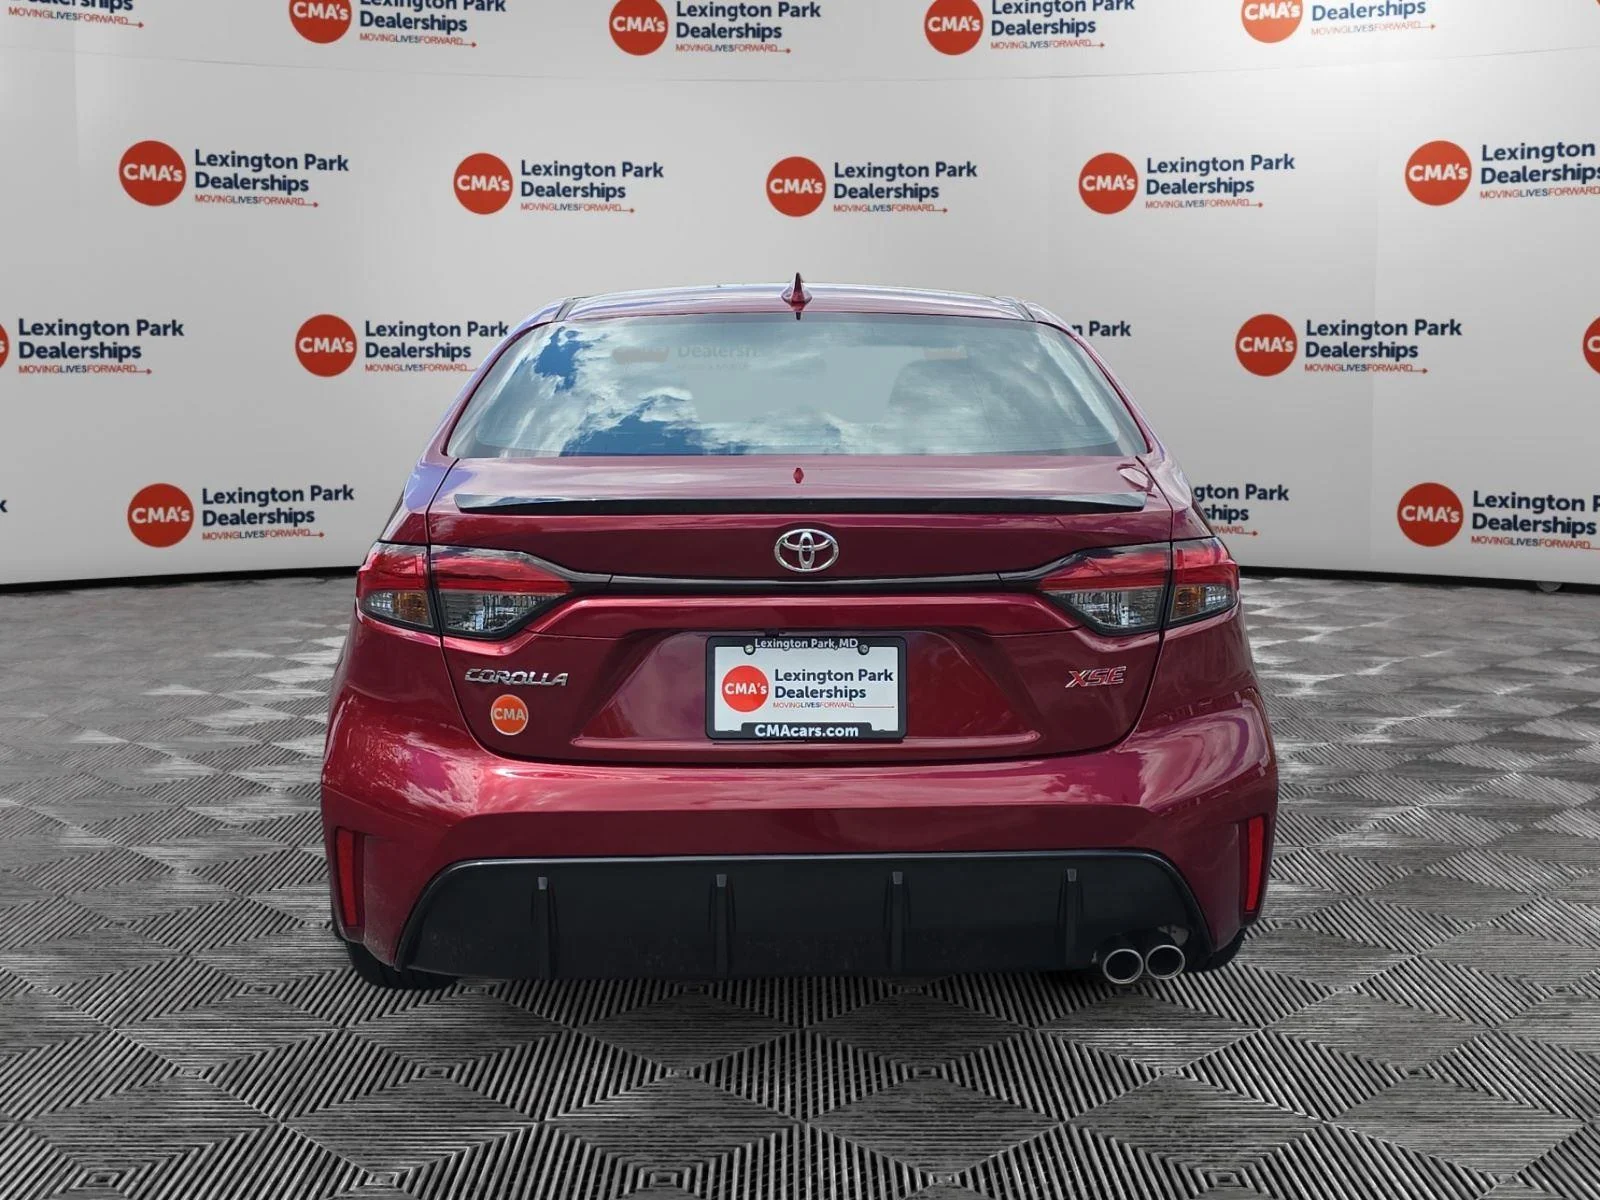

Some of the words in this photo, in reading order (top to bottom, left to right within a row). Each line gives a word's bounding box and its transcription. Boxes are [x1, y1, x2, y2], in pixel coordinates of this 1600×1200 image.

[293, 2, 349, 20] CMA's
[360, 0, 457, 12] xngton
[676, 1, 772, 21] Lexington
[778, 1, 821, 17] Park
[991, 0, 1086, 17] Lexington
[1093, 0, 1135, 11] Park
[1244, 2, 1301, 20] CMA's
[1312, 0, 1426, 21] Dealerships
[360, 11, 468, 35] Dealerships
[613, 16, 666, 32] CMA's
[676, 22, 782, 41] Dealerships
[928, 16, 981, 32] CMA's
[991, 18, 1096, 37] Dealerships
[195, 149, 298, 172] Lexington
[304, 153, 349, 171] Park
[1482, 141, 1595, 163] Lexington
[123, 163, 183, 182] CMA's
[521, 160, 615, 180] Lexington
[622, 162, 664, 178] Park
[834, 162, 929, 182] Lexington
[935, 161, 977, 177] Park
[1147, 157, 1244, 176] Lexington
[1250, 153, 1295, 171] Park
[1408, 163, 1469, 182] CMA's
[195, 171, 309, 195] Dealerships
[456, 174, 510, 192] CMA's
[521, 181, 626, 201] Dealerships
[770, 178, 823, 194] CMA's
[1082, 174, 1135, 191] CMA's
[1146, 177, 1255, 197] Dealerships
[834, 183, 939, 202] Dealerships
[19, 318, 130, 339] Lexington
[136, 318, 184, 336] Park
[365, 320, 461, 341] Lexington
[467, 321, 508, 337] Park
[1089, 320, 1131, 337] Park
[1306, 319, 1408, 340] Lexington
[1414, 319, 1462, 336] Park
[19, 341, 142, 361] Dealerships
[298, 337, 354, 353] CMA's
[365, 342, 471, 361] Dealerships
[1238, 336, 1294, 353] CMA's
[1305, 341, 1418, 362] Dealerships
[202, 487, 304, 507] Lexington
[310, 484, 354, 502] Park
[1245, 483, 1289, 501] Park
[1473, 490, 1586, 514] Lexington
[131, 506, 190, 525] CMA's
[202, 508, 315, 527] Dealerships
[1401, 505, 1460, 523] CMA's
[1472, 513, 1597, 538] Dealerships
[754, 638, 809, 651] Lexington
[464, 668, 569, 686] COROLLA
[775, 668, 854, 684] Lexington
[858, 669, 893, 681] Park
[1064, 665, 1127, 689] XSE
[724, 682, 768, 695] CMA's
[775, 685, 866, 701] Dealerships
[493, 708, 525, 721] CMA
[754, 724, 859, 737] CMAcars.com
